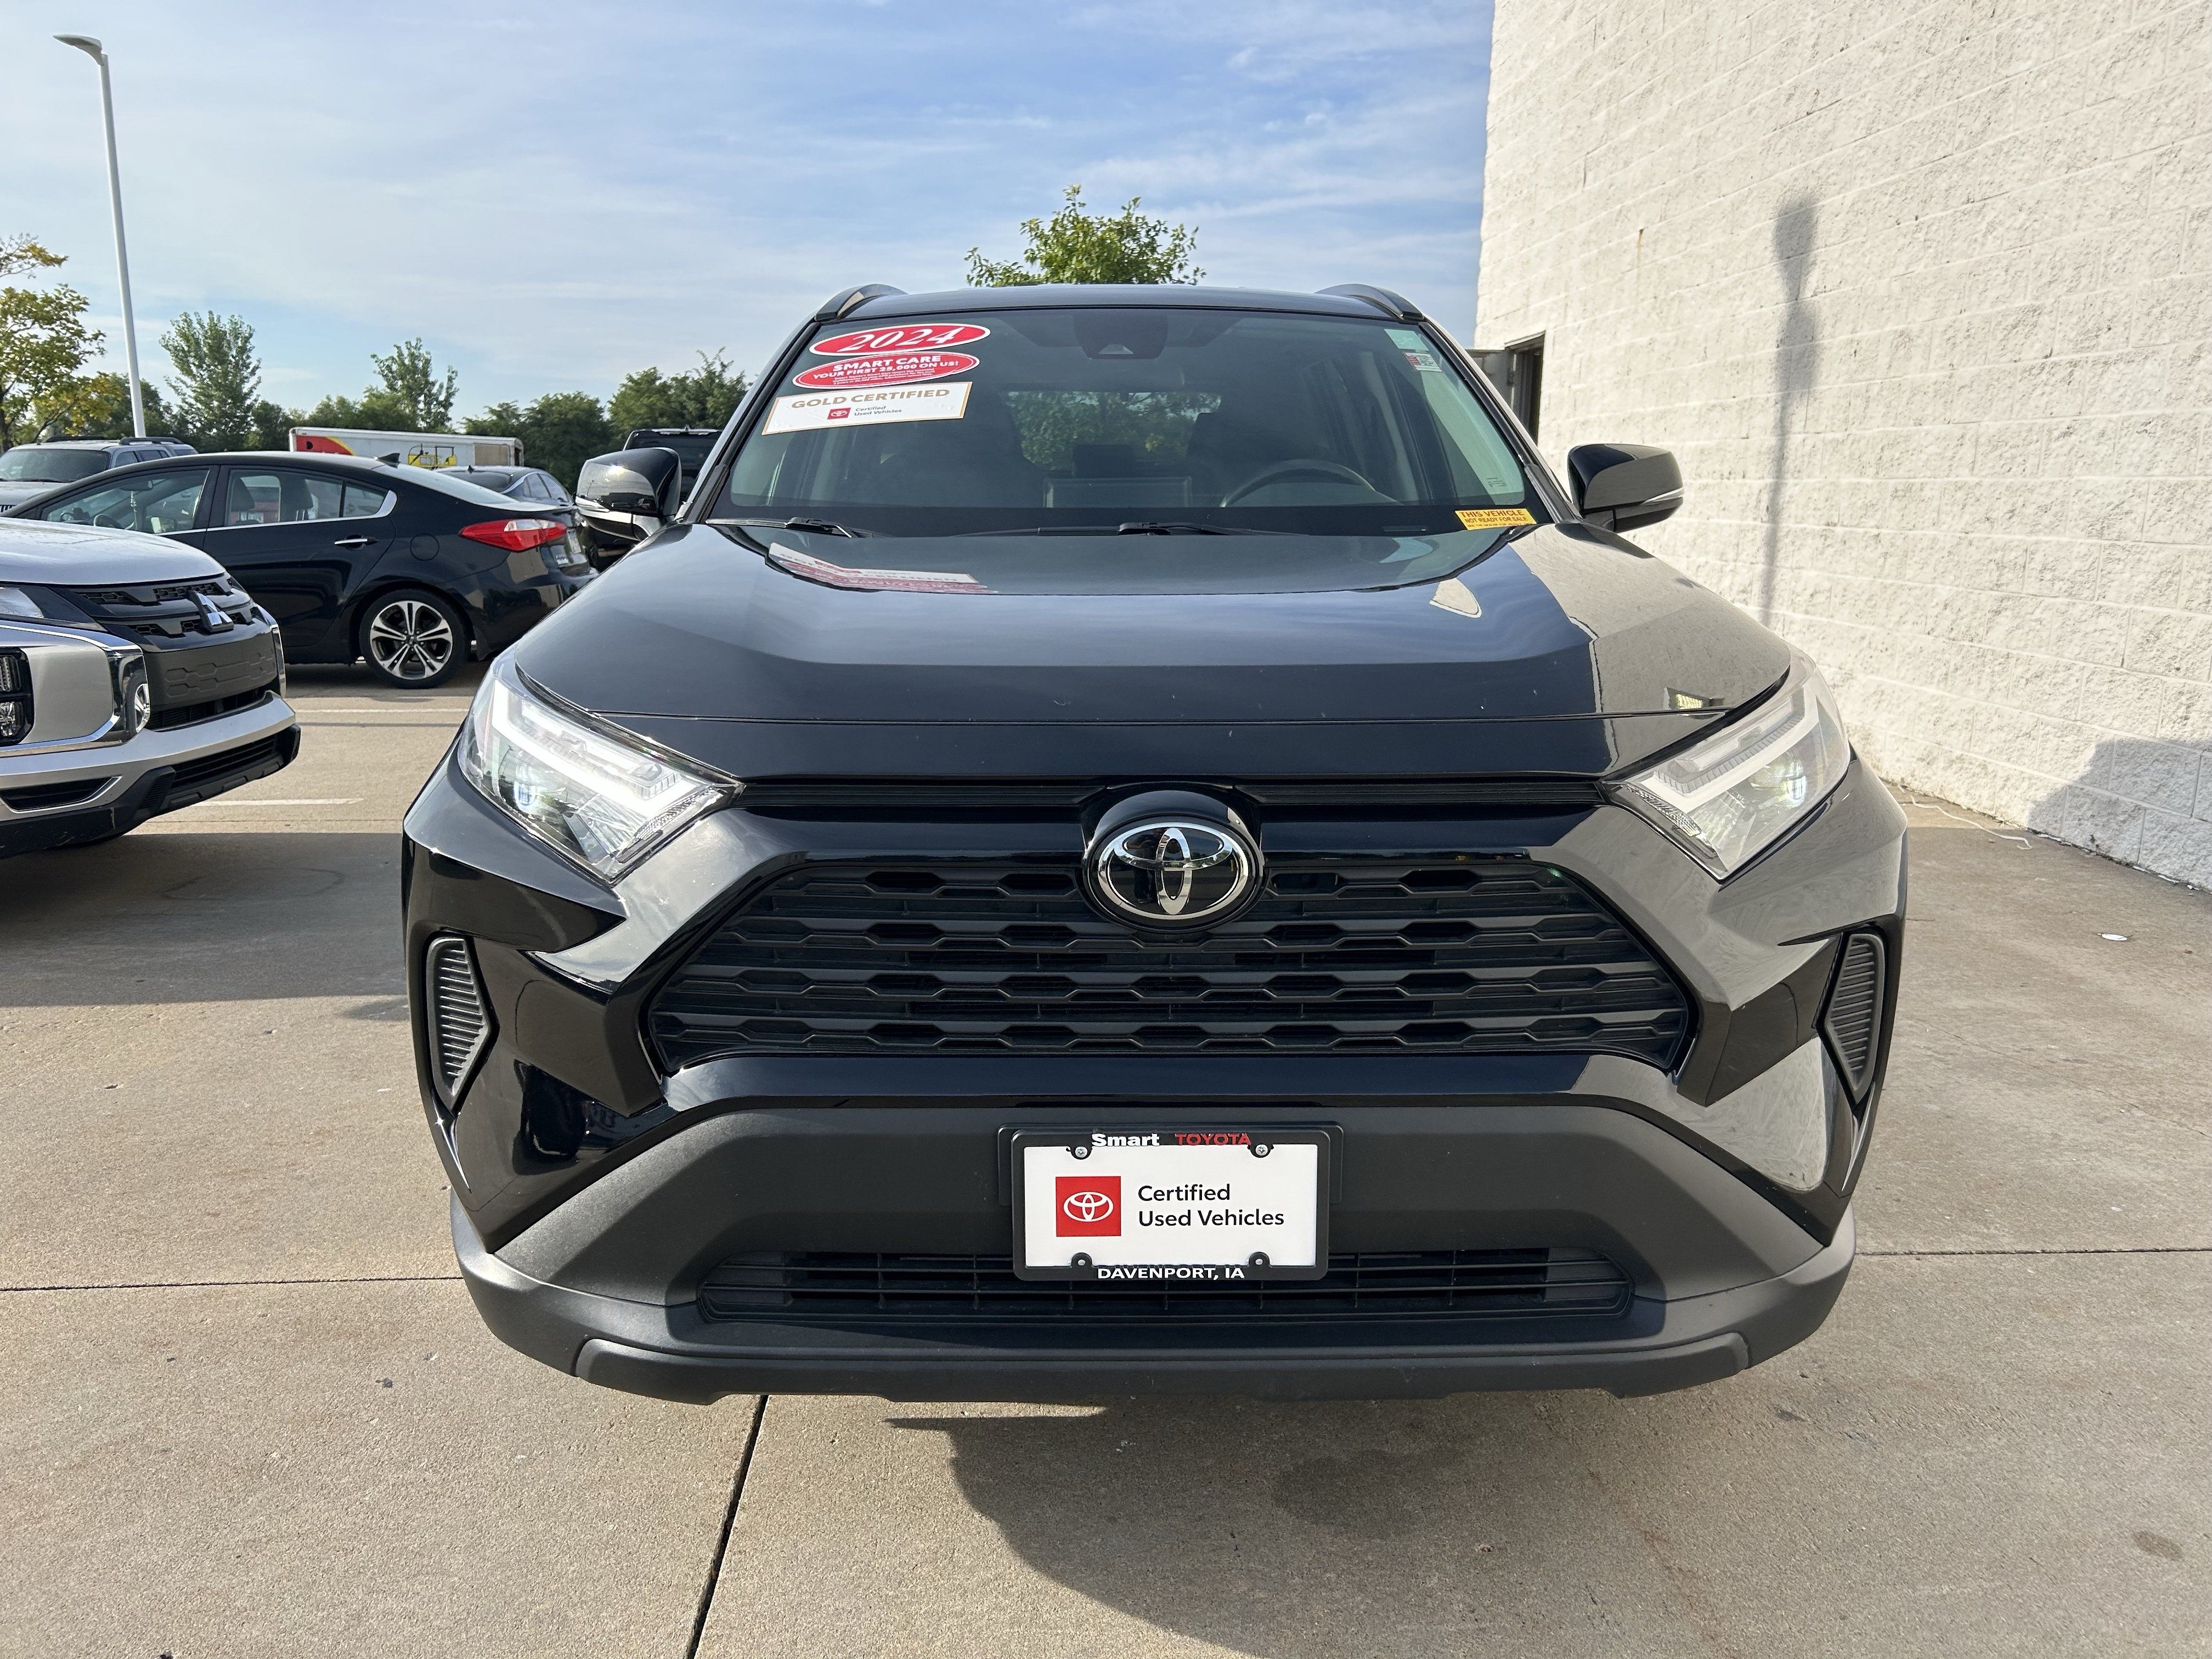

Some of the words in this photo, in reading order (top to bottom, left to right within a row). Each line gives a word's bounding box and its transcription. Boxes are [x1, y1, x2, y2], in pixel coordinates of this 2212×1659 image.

[837, 328, 965, 352] 2024
[832, 359, 894, 371] SMART
[896, 355, 942, 365] CARE
[813, 371, 845, 380] YOUR
[846, 367, 878, 376] FIRST
[791, 396, 847, 408] GOLD
[851, 389, 950, 403] CERTIFIED
[1091, 1133, 1160, 1147] Smart
[1174, 1132, 1251, 1146] TOYOTA
[1138, 1183, 1231, 1201] Certified
[1138, 1209, 1191, 1227] Used
[1197, 1208, 1285, 1226] Vehicles
[1097, 1267, 1220, 1280] DAVENPORT,
[1224, 1267, 1245, 1279] IA
